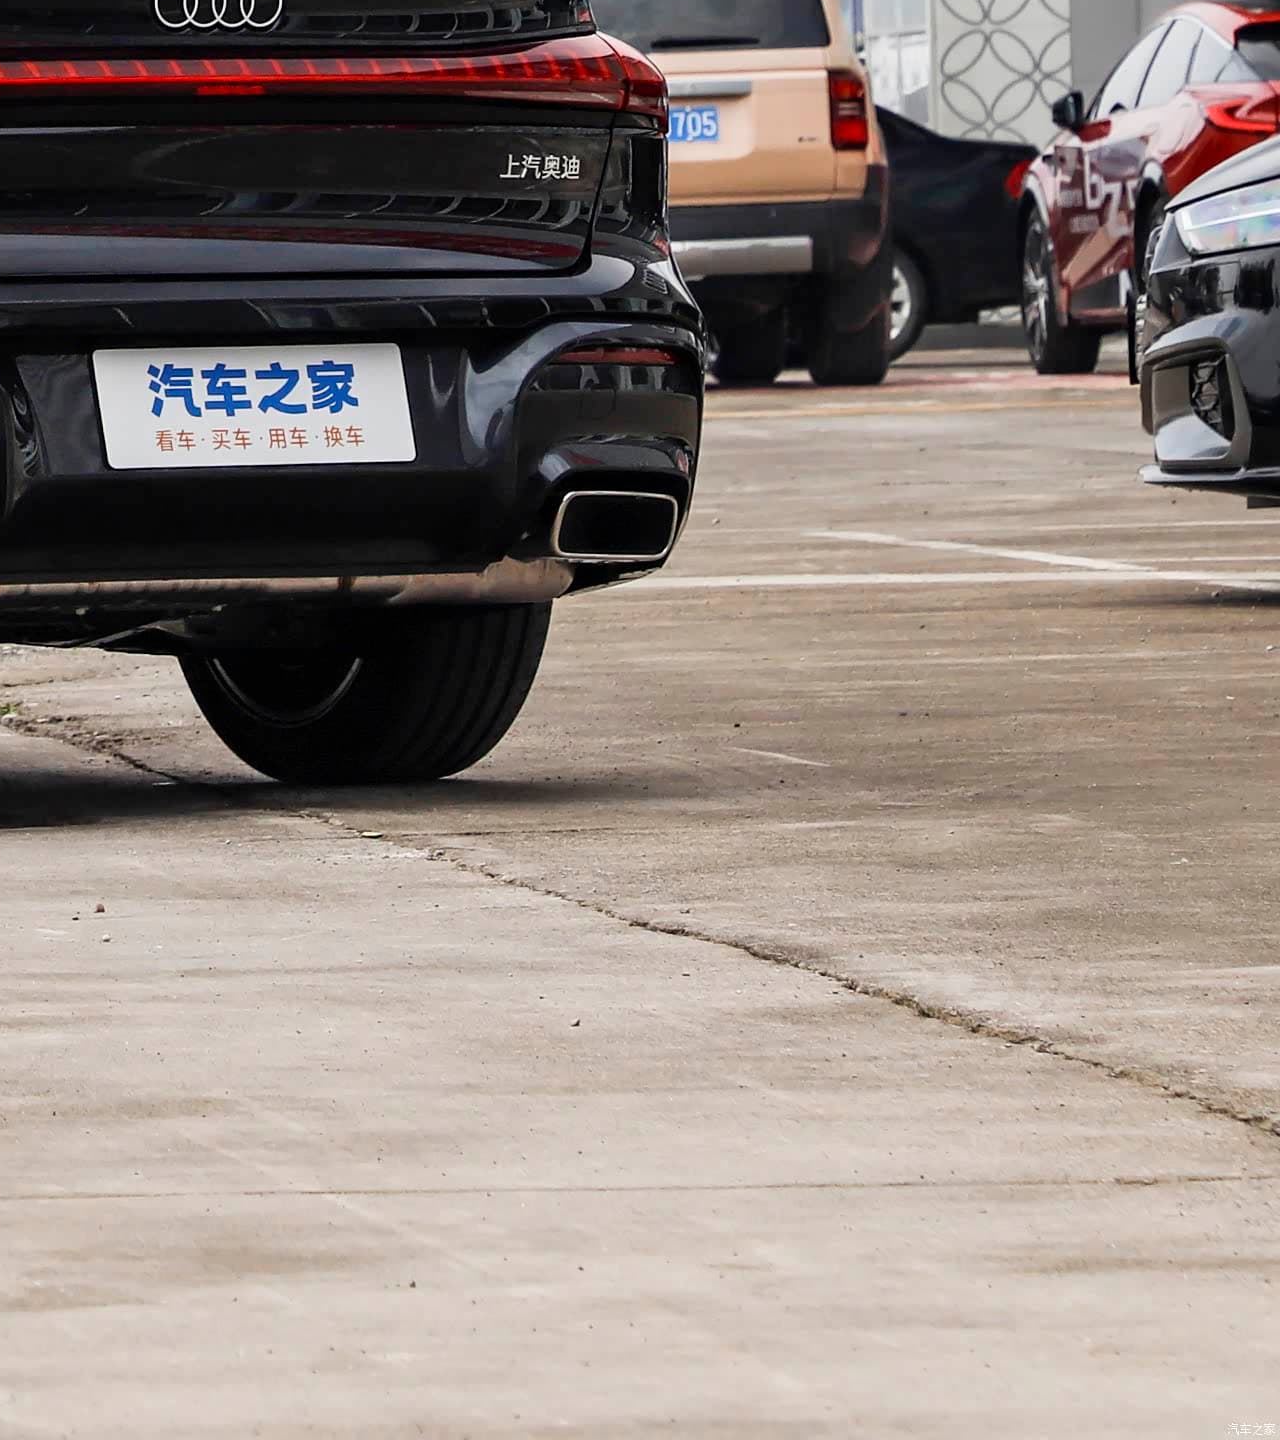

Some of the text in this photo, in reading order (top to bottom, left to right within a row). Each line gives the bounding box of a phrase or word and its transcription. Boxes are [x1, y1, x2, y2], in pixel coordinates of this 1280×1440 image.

[499, 154, 580, 179] 上汽奥迪
[146, 360, 360, 417] 汽车之家
